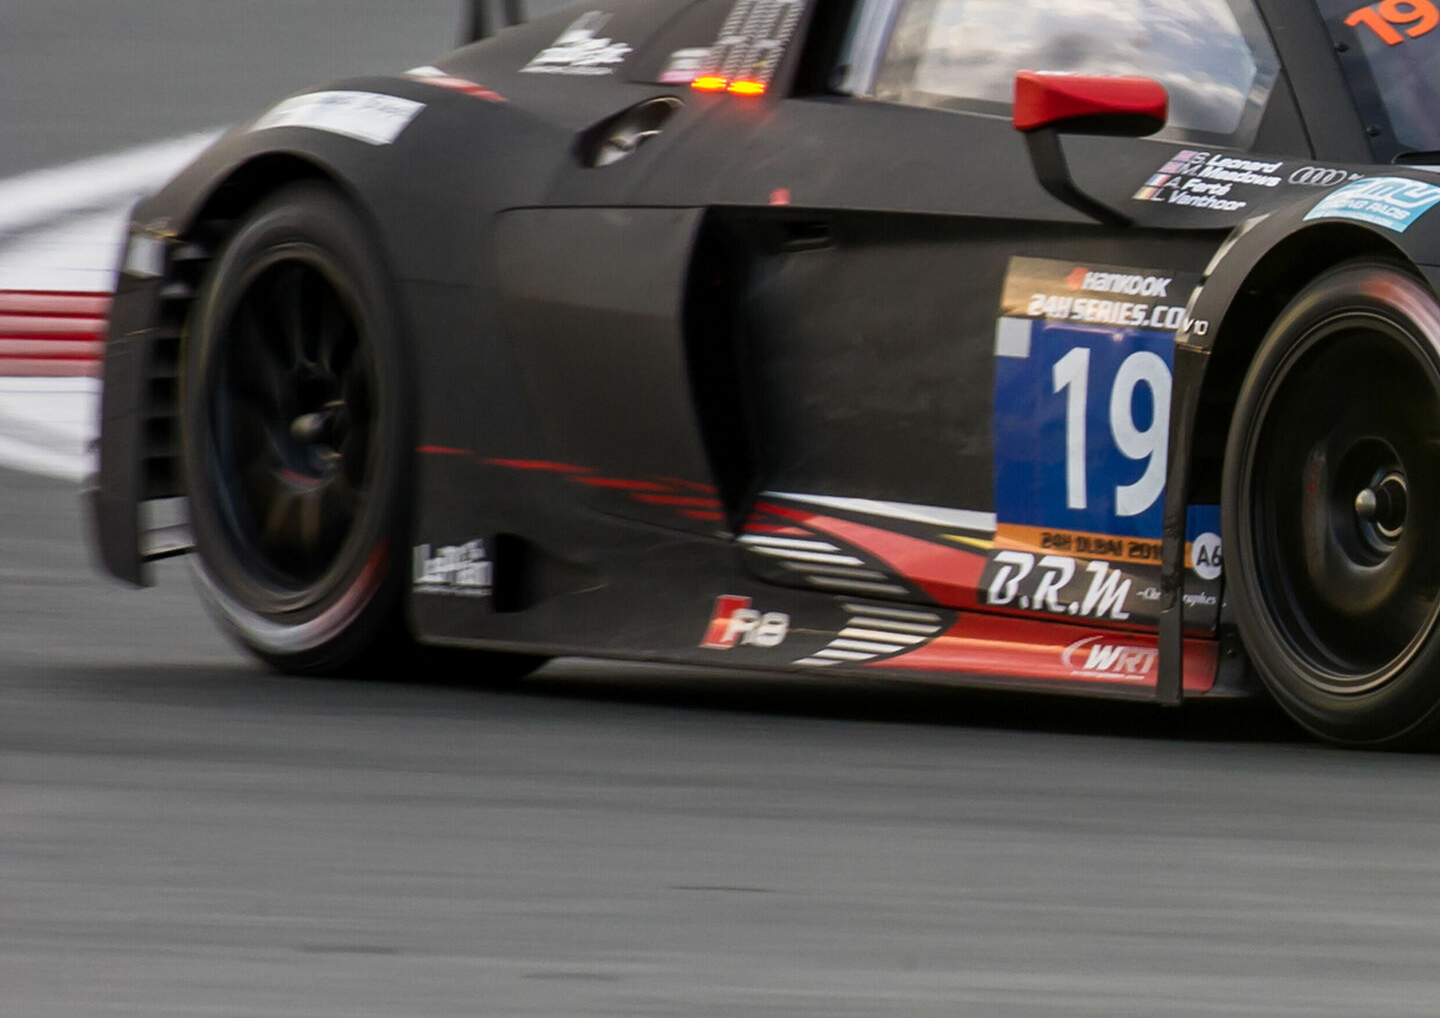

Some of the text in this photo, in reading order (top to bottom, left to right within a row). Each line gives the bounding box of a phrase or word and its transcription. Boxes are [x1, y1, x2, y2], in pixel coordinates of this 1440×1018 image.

[1206, 154, 1283, 173] Leonard
[1199, 165, 1282, 187] Meadows
[1168, 190, 1247, 211] Vanthoor
[1052, 346, 1173, 517] 19
[1196, 545, 1223, 567] A6
[720, 608, 790, 648] R8
[1083, 644, 1158, 673] WRT
